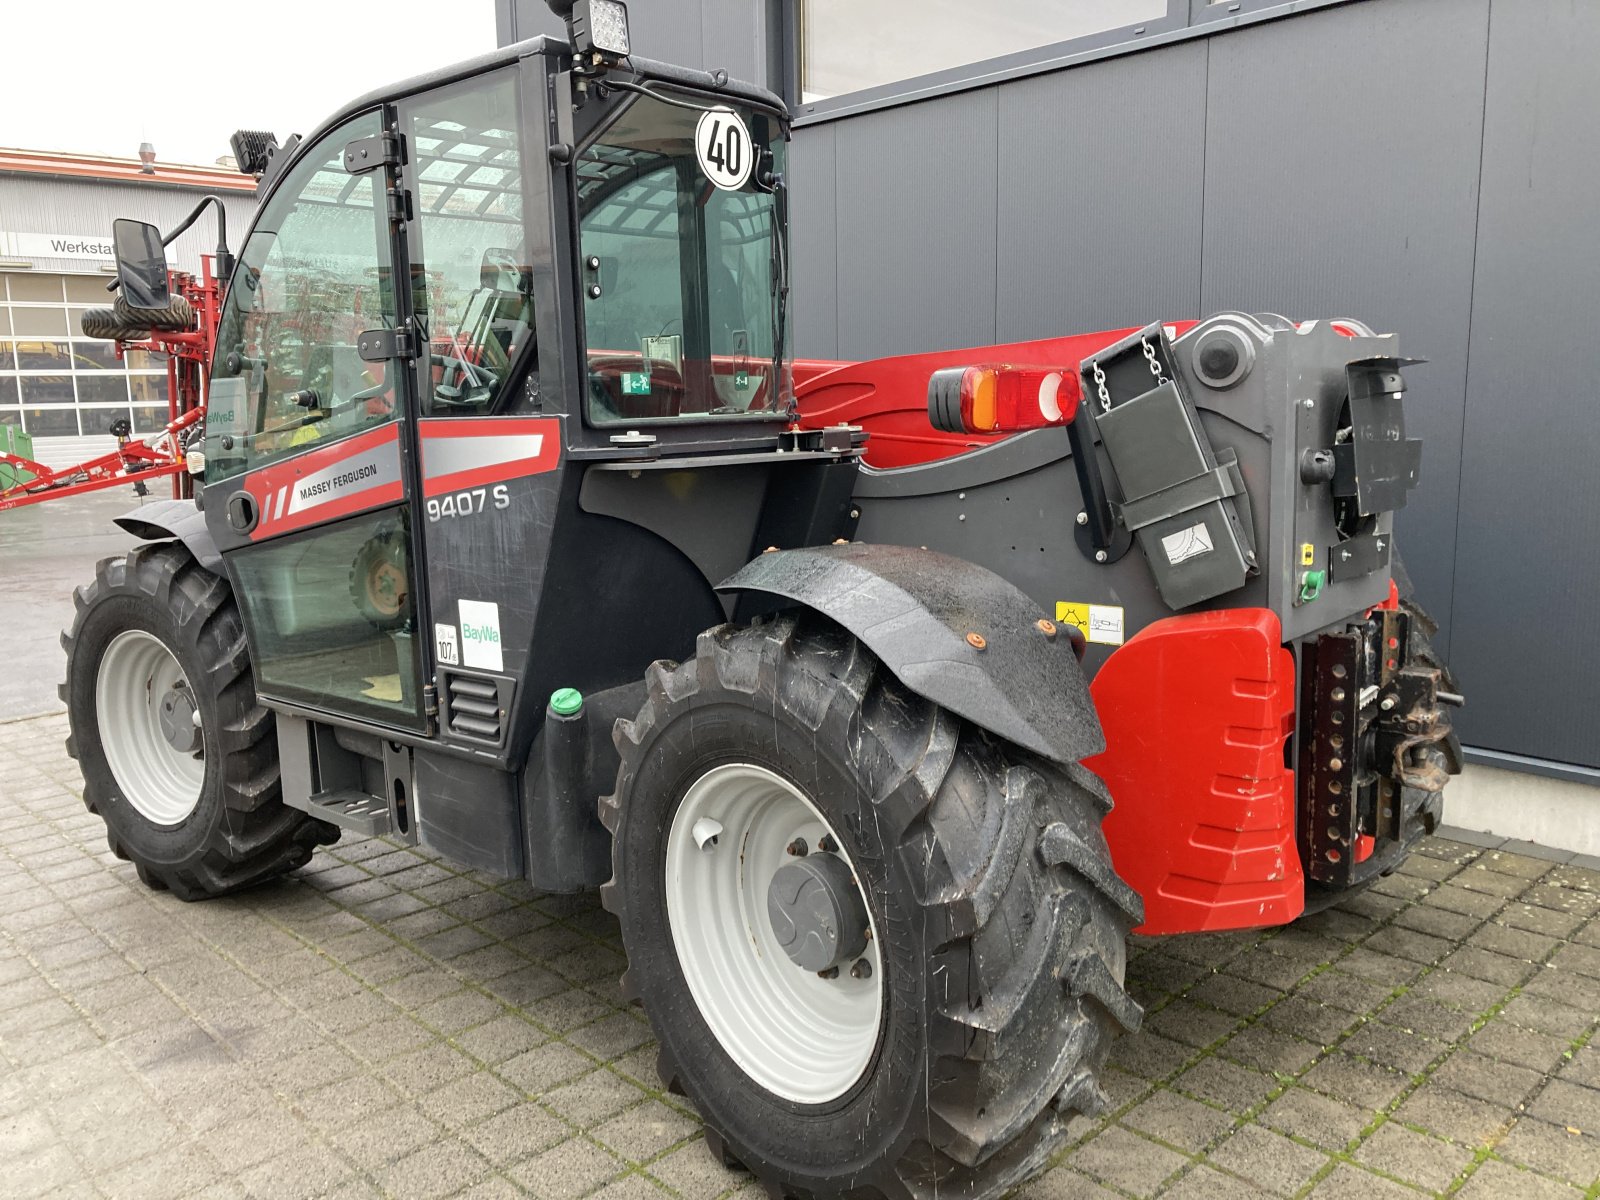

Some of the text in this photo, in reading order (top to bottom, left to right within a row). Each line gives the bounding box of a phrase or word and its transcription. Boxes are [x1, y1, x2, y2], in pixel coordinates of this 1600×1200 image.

[707, 119, 740, 176] 40
[300, 464, 377, 500] MASSEY FERGUSON
[427, 484, 511, 523] 9407 S
[438, 641, 453, 660] 107
[462, 623, 499, 644] BayWa
